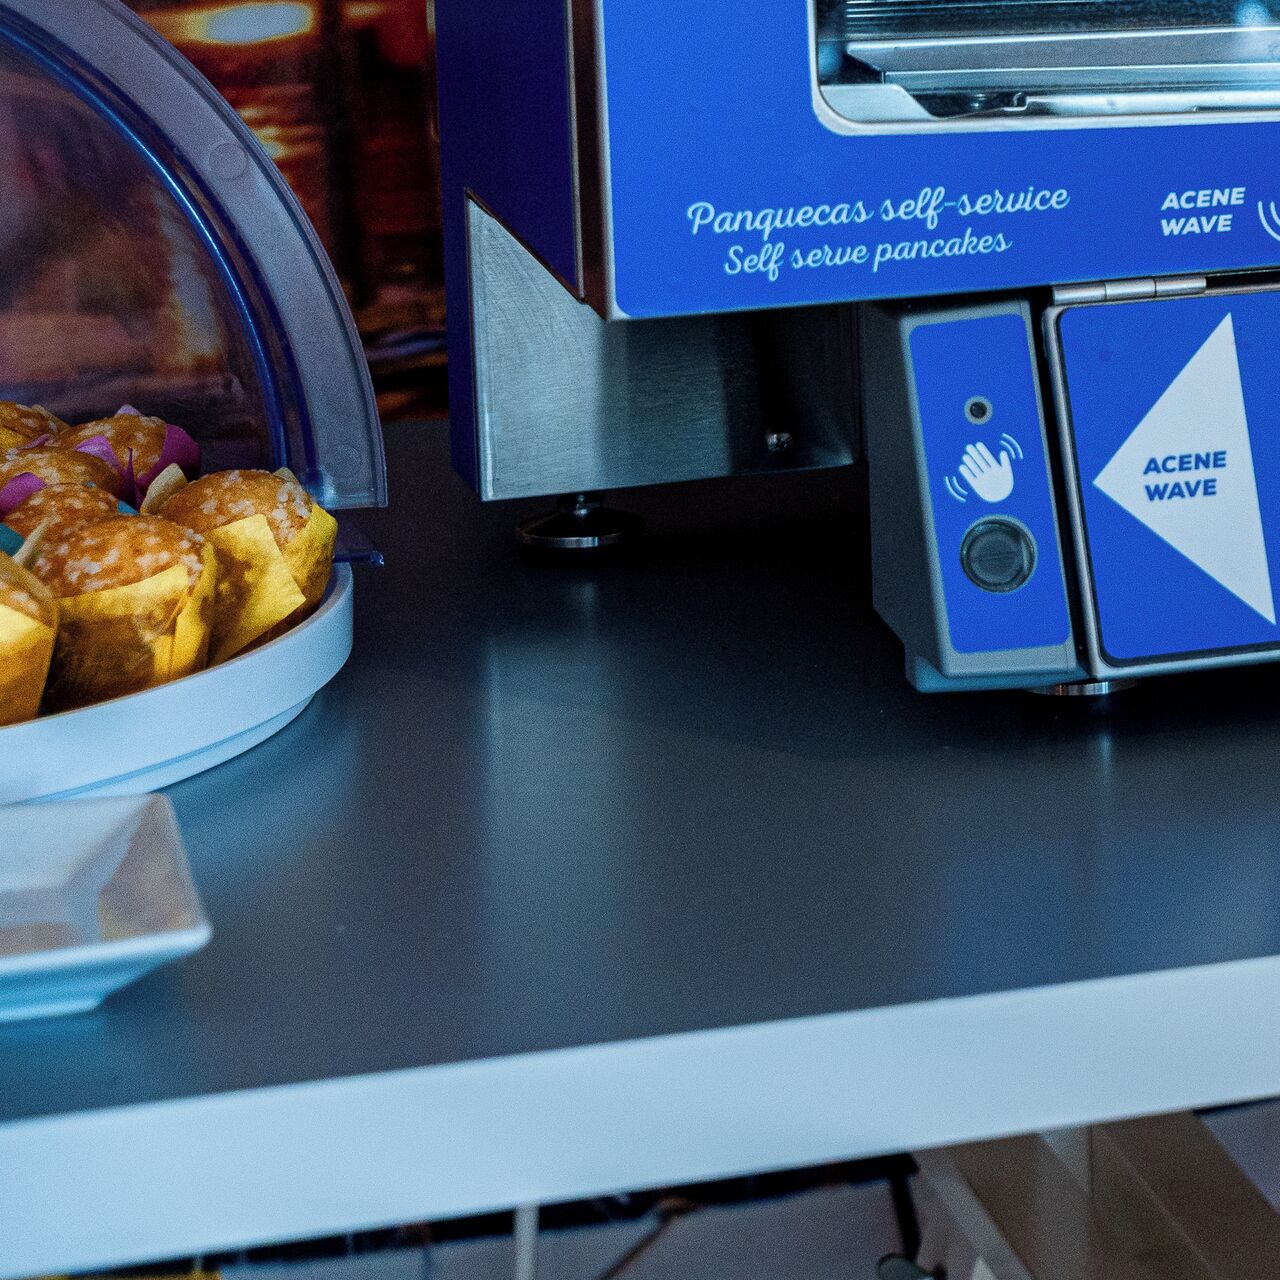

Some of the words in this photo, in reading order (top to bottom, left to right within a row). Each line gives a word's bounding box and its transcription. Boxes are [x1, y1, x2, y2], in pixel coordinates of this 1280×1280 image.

[1161, 187, 1246, 211] ACENE
[687, 200, 874, 241] Panquecas
[880, 186, 1071, 229] self-service
[1161, 214, 1233, 236] WAVE
[724, 241, 785, 281] Self
[791, 244, 869, 269] serve
[873, 227, 1012, 271] pancakes
[1143, 451, 1227, 475] ACENE
[1144, 478, 1217, 501] WAVE
